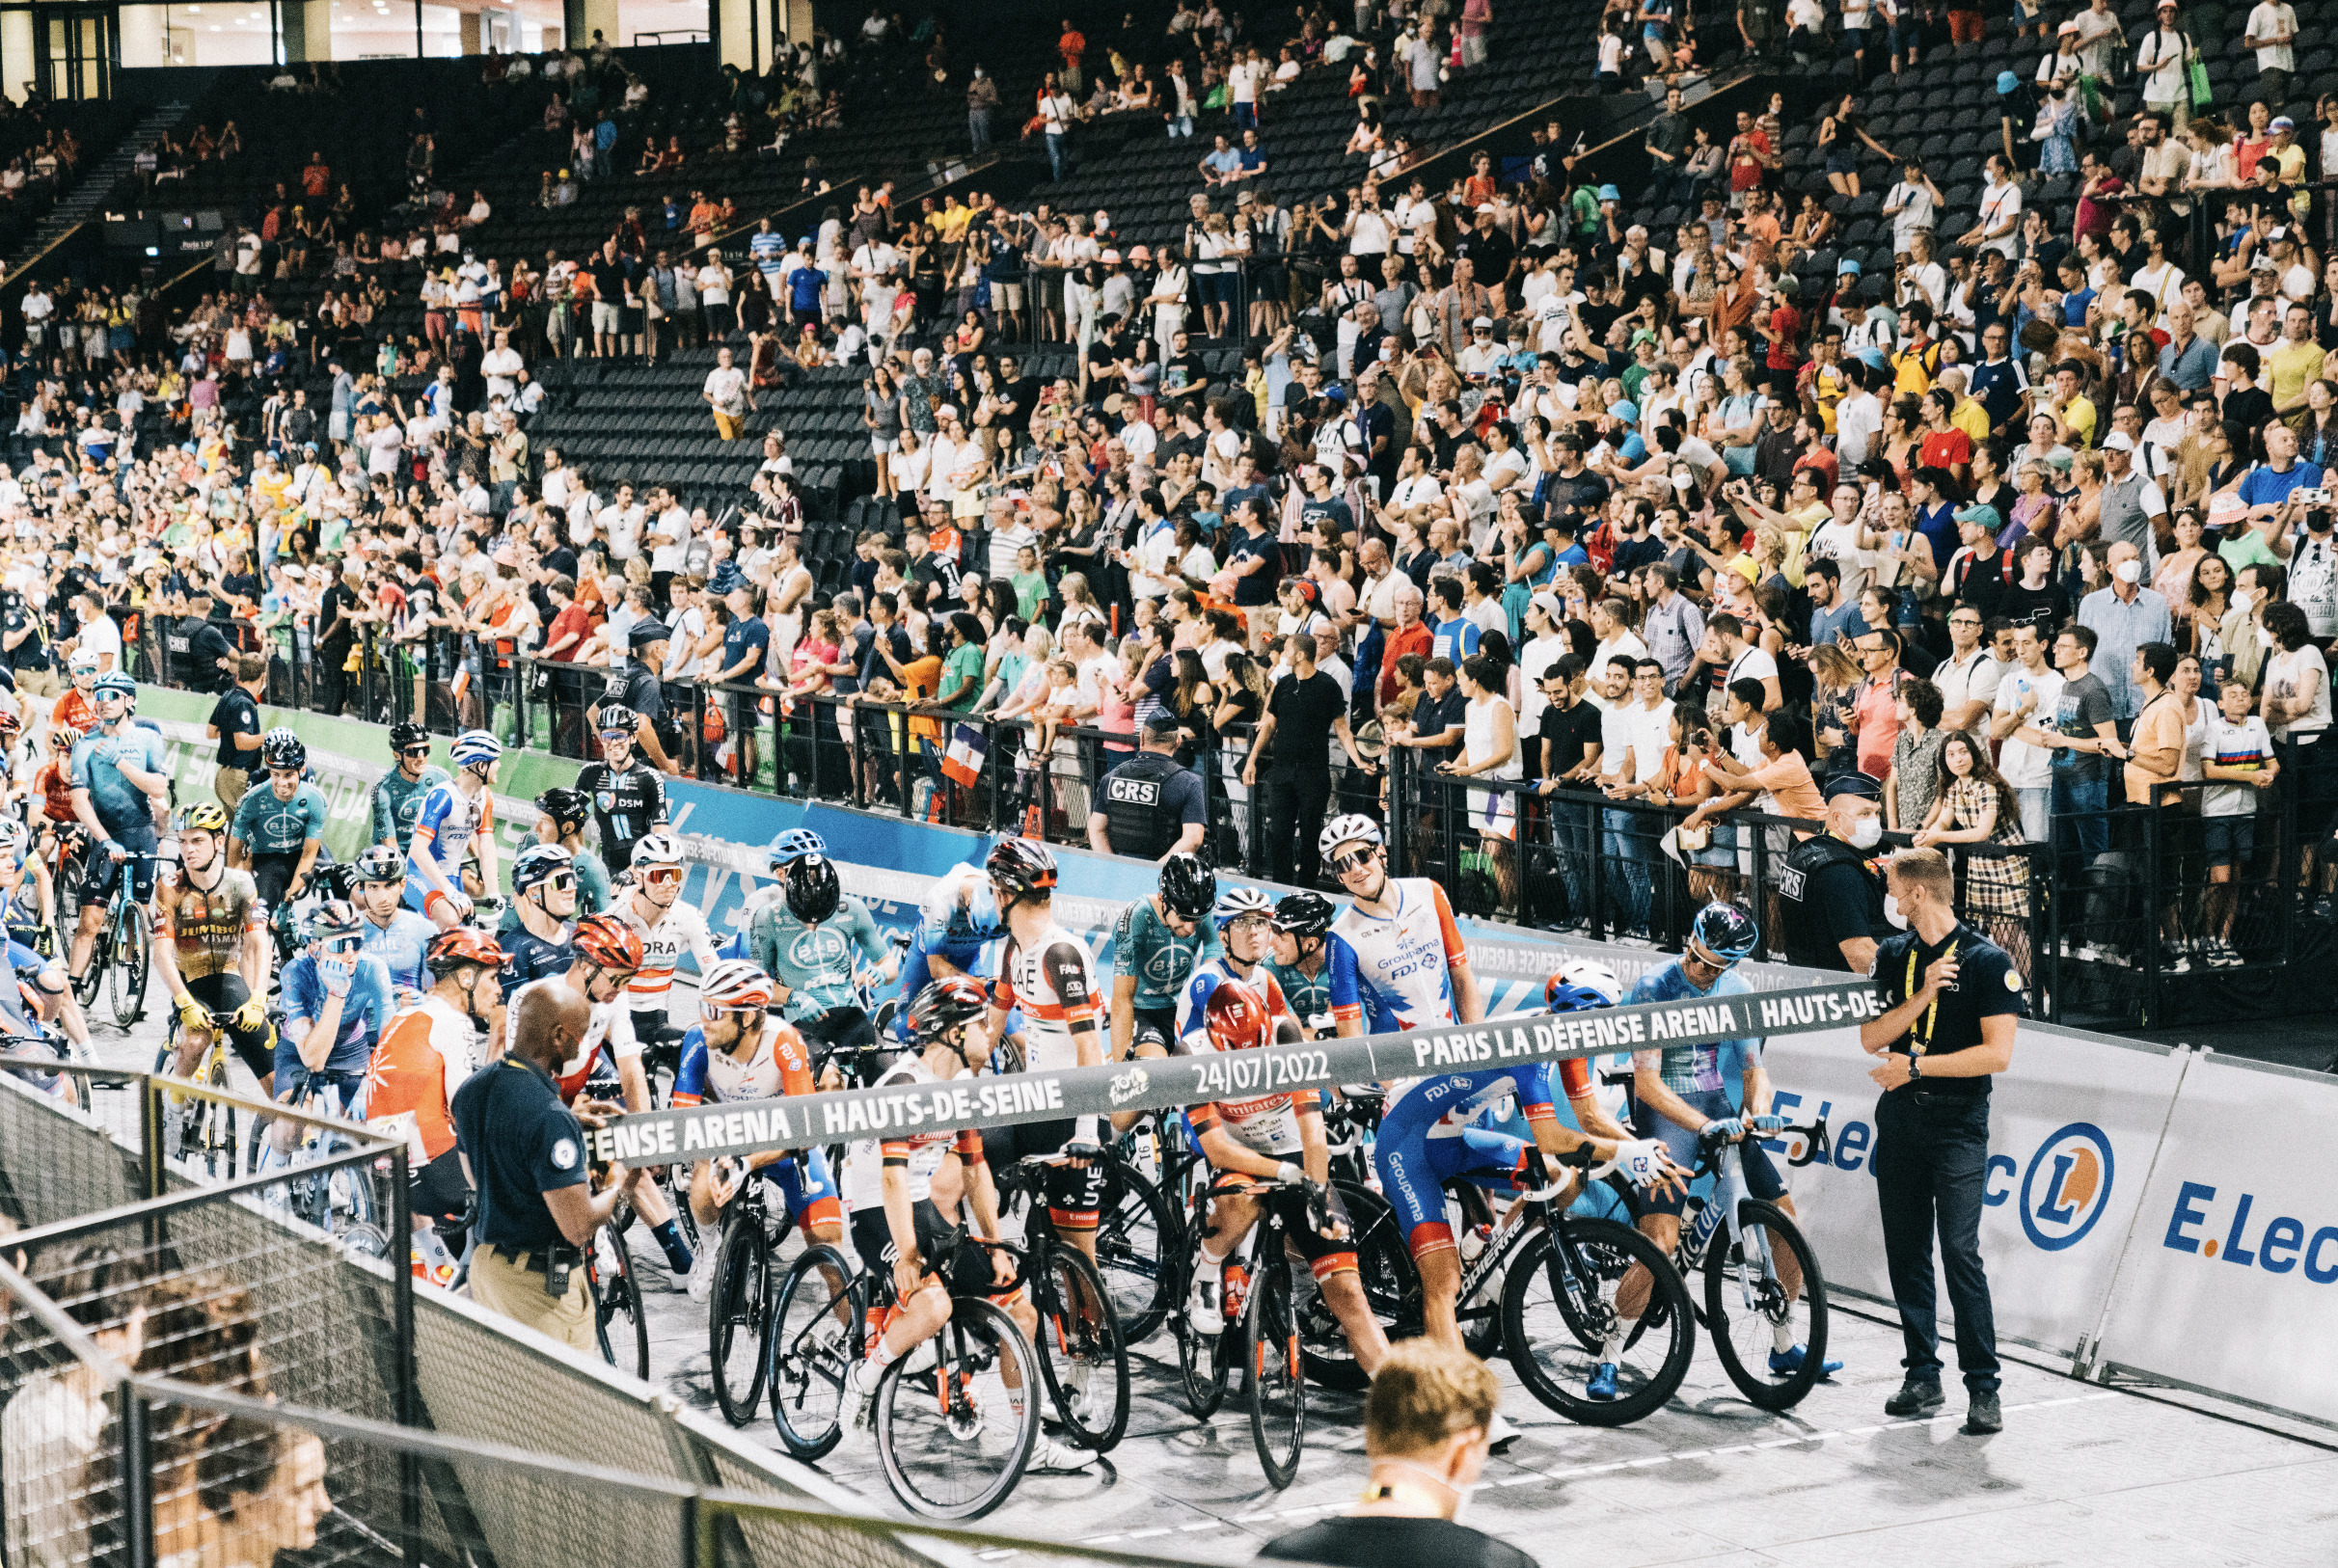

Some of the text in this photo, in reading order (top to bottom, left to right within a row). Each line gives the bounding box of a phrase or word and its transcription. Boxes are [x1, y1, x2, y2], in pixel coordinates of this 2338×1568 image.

[169, 636, 188, 653] CRS
[1111, 779, 1155, 803] CRS
[618, 798, 644, 809] DSM
[1781, 867, 1801, 898] CRS
[180, 924, 238, 937] JUMBO
[201, 933, 238, 944] VISMA
[1377, 938, 1440, 970] Groupama
[1391, 961, 1418, 982] FDJ
[1412, 1032, 1492, 1068] PARIS
[1497, 1025, 1533, 1059] LA
[1536, 1014, 1645, 1054] DÉFENSE
[1651, 1004, 1738, 1041] ARENA
[1191, 1049, 1331, 1095] 24/07/2022
[1425, 1082, 1451, 1103] FDJ
[683, 1107, 794, 1152] ARENA
[821, 1078, 1065, 1136] HAUTS-DE-SEINE
[1226, 1093, 1285, 1117] mirates
[1082, 1166, 1103, 1206] UAE
[1387, 1149, 1425, 1223] Groupama
